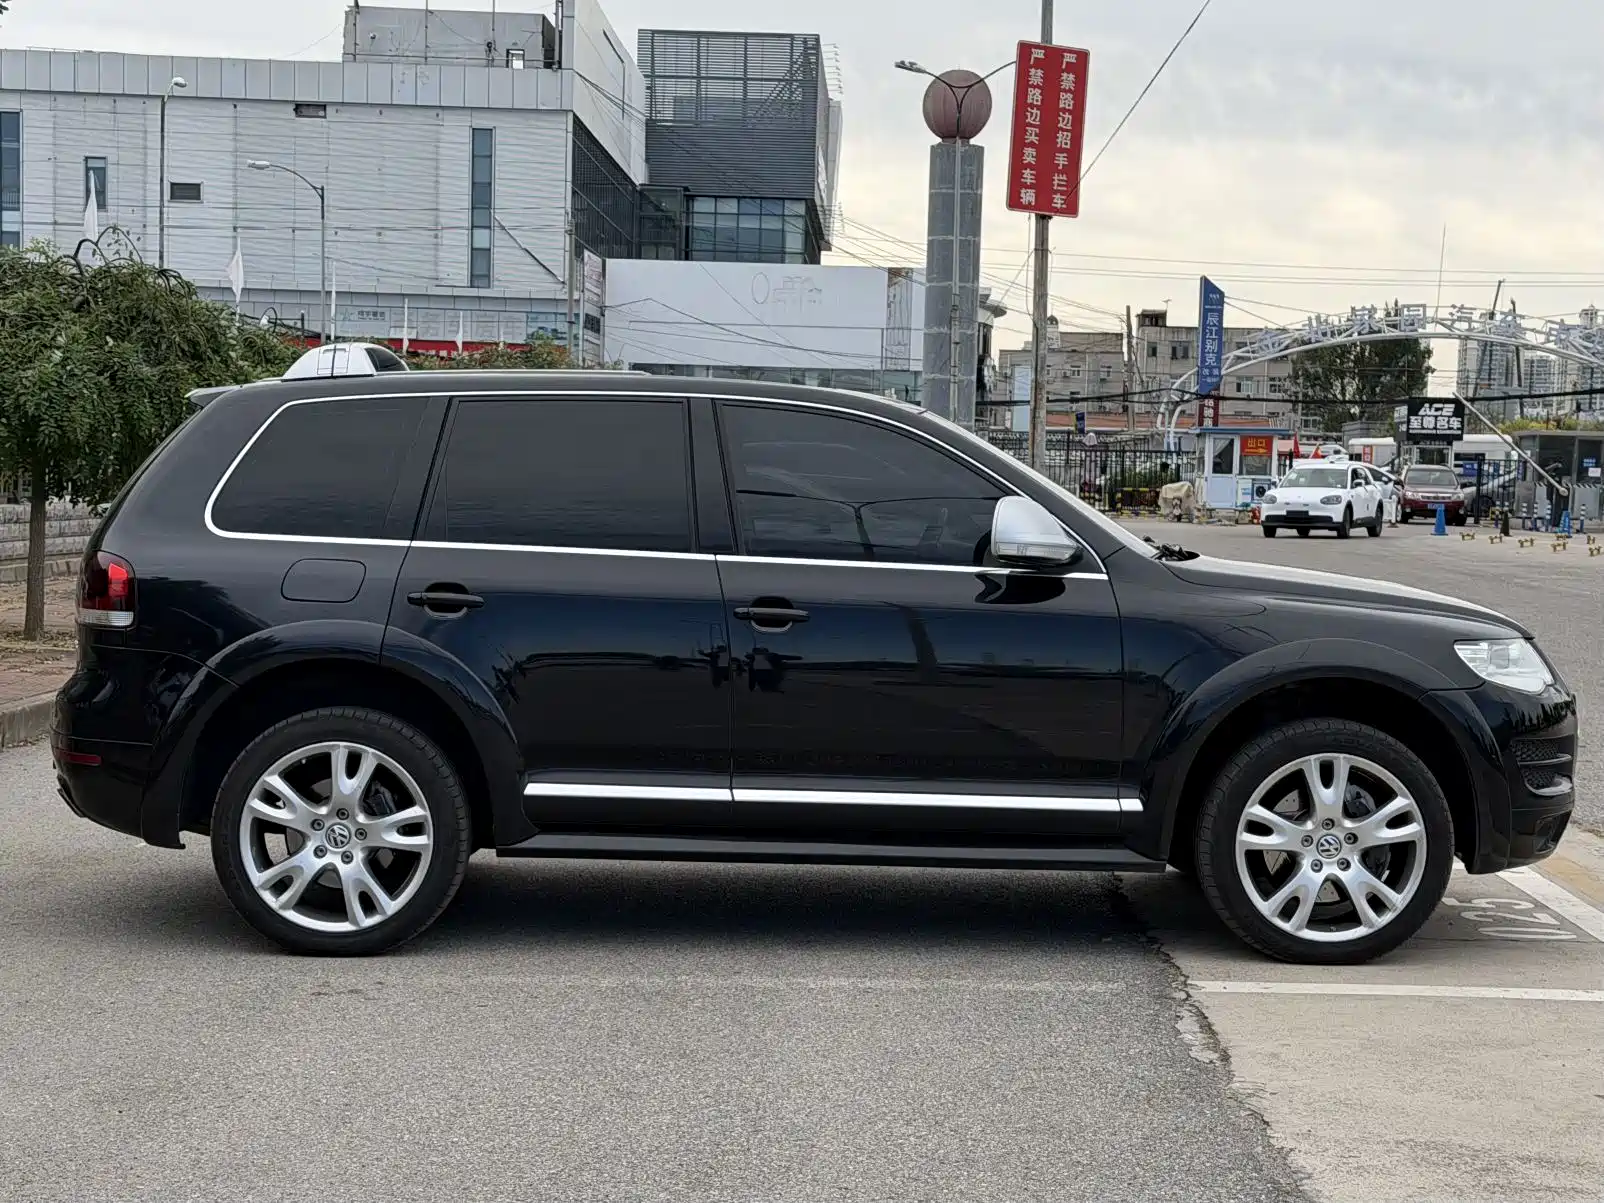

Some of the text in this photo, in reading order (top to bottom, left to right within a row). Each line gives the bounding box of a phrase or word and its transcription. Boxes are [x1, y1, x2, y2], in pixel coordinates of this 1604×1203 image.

[1020, 48, 1045, 206] 严禁路边买卖车辆
[1051, 52, 1077, 209] 严禁路边招手拦车
[1205, 312, 1219, 366] 辰江别克
[1247, 437, 1266, 448] 出口
[1409, 416, 1462, 429] 至尊名车
